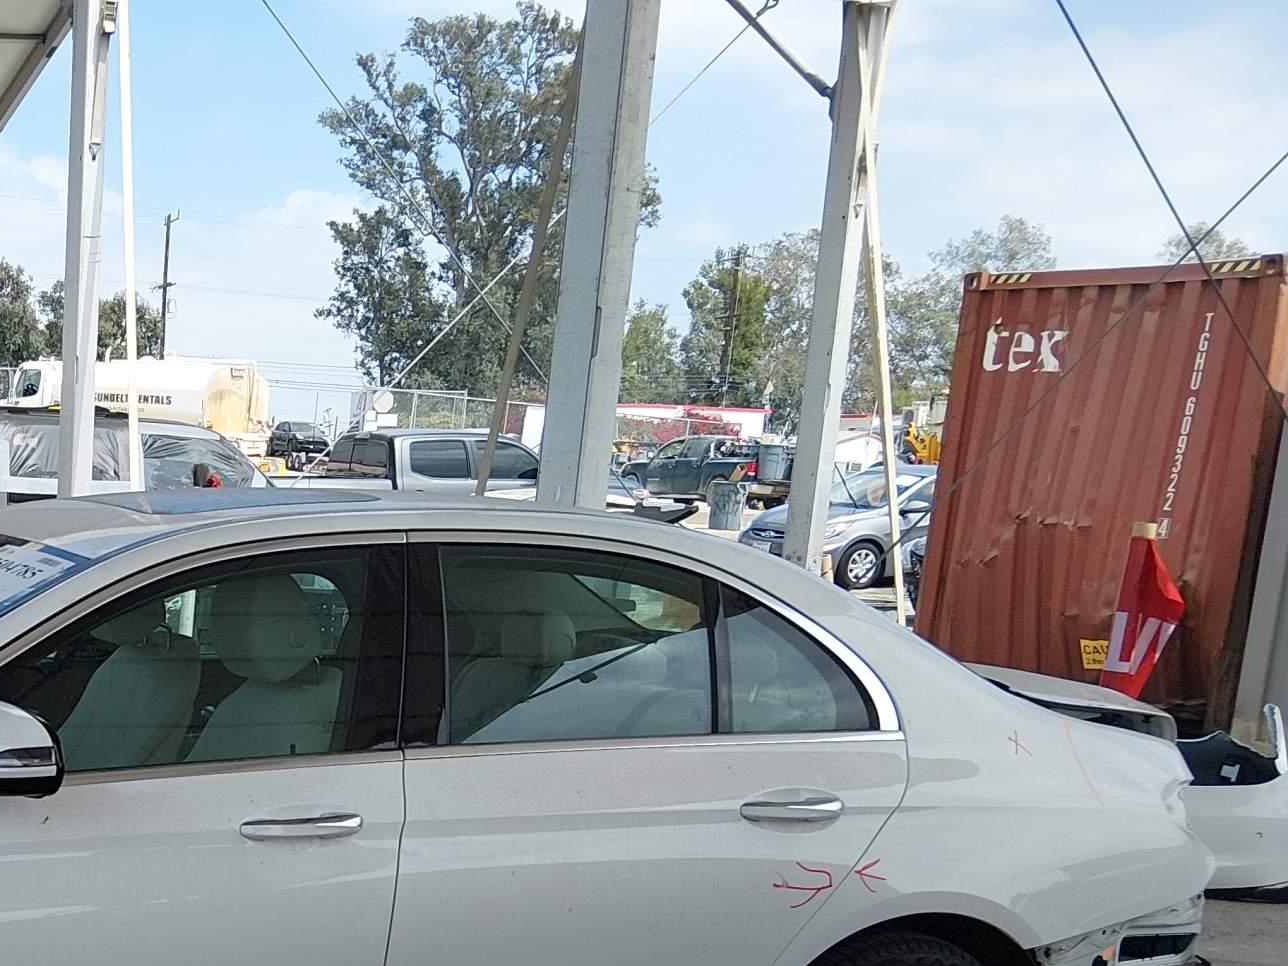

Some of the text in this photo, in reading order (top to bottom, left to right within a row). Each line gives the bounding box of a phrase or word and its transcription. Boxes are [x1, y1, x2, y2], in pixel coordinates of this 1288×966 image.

[982, 316, 1069, 373] tex
[1190, 312, 1215, 391] TGHU
[137, 394, 172, 406] ENTALS
[1162, 396, 1197, 512] 609322
